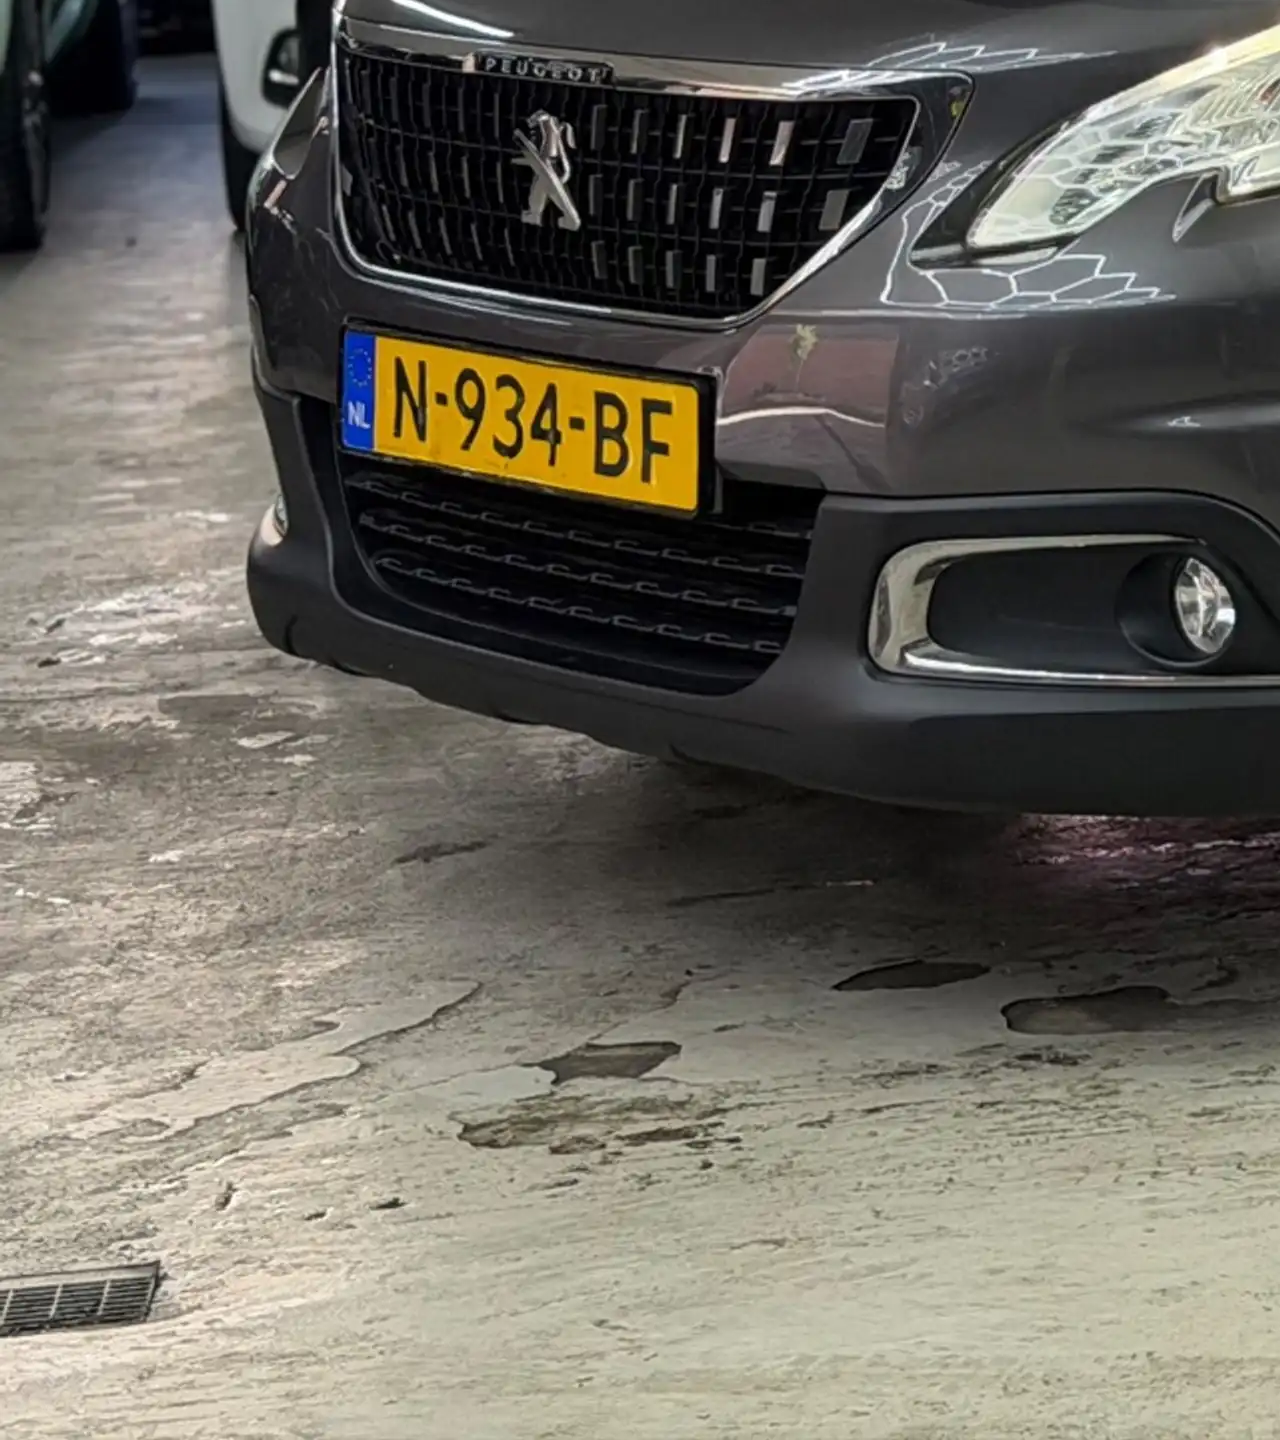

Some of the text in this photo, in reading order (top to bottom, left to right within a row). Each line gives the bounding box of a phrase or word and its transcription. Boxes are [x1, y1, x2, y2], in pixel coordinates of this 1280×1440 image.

[485, 54, 602, 84] PEUGEOT
[347, 400, 371, 429] NL
[393, 356, 674, 484] N-934-BF
